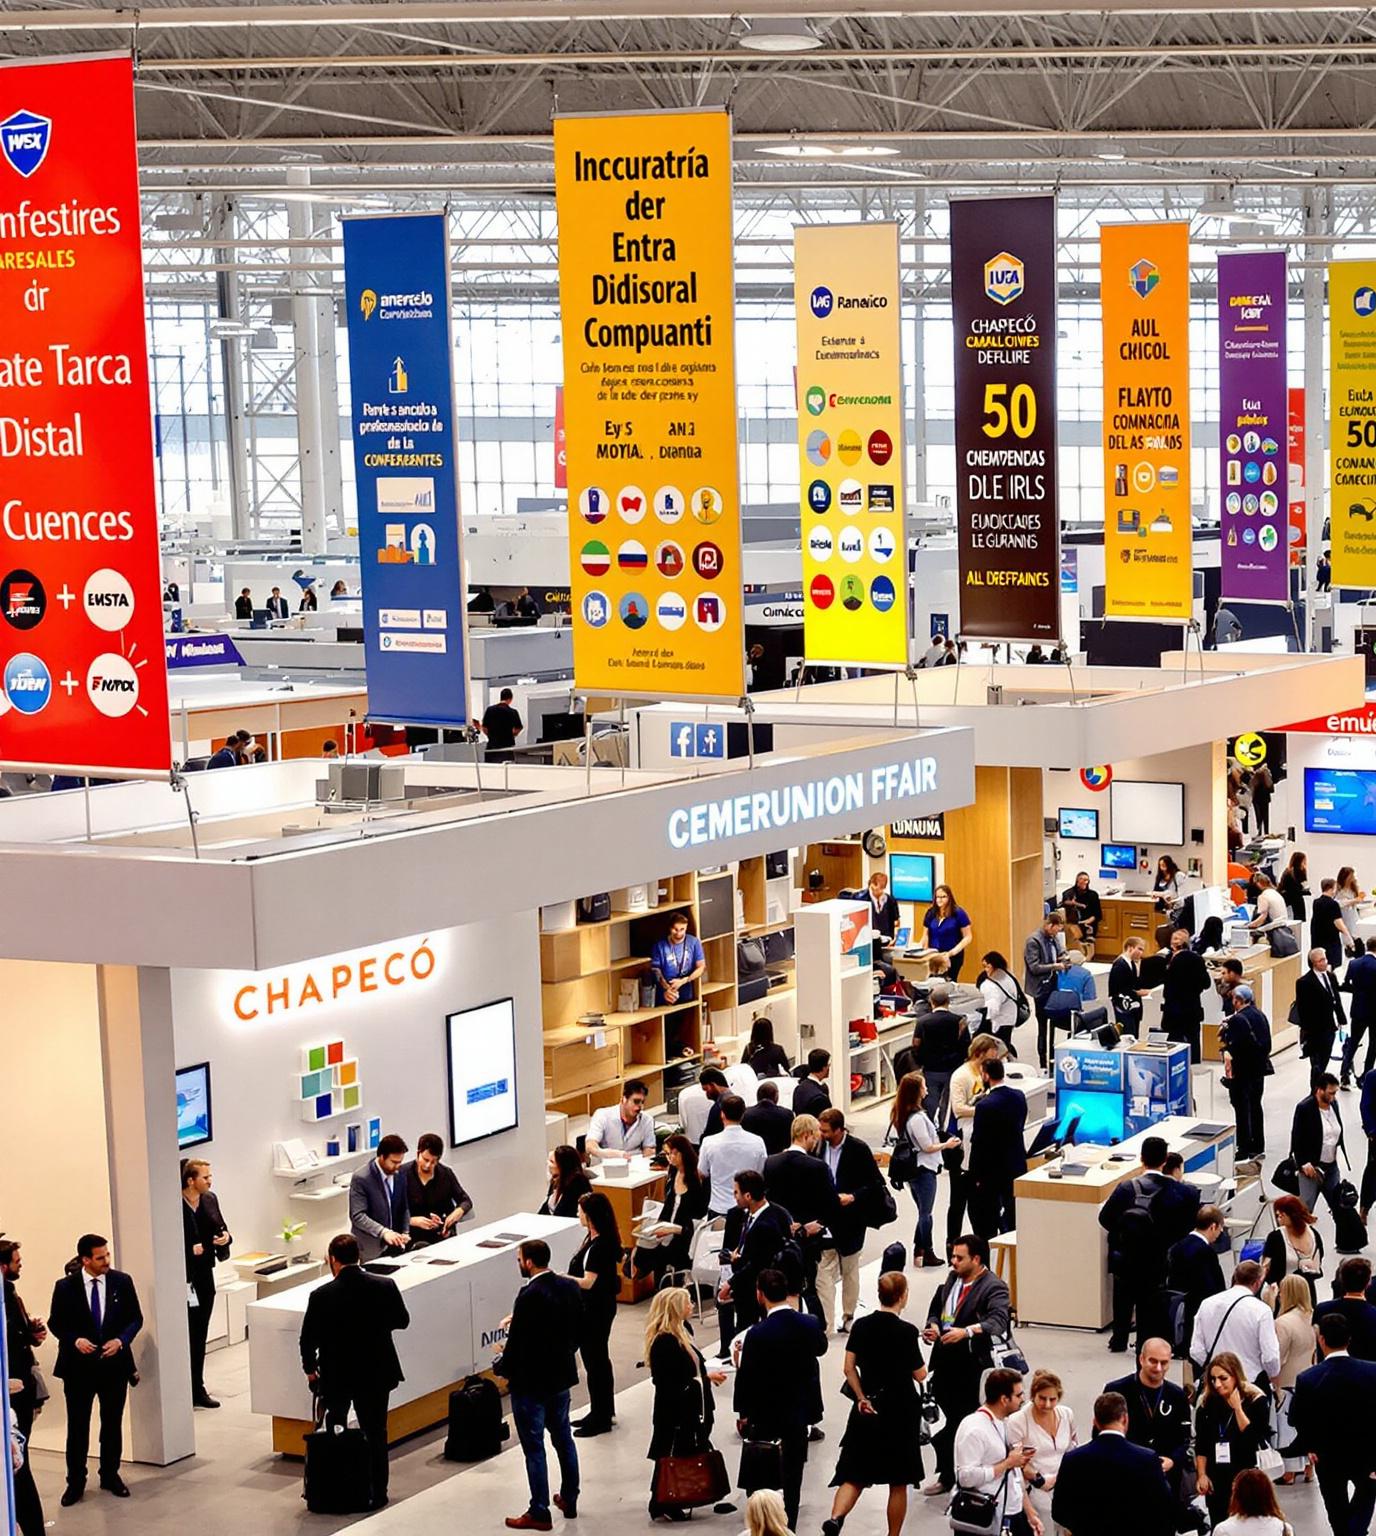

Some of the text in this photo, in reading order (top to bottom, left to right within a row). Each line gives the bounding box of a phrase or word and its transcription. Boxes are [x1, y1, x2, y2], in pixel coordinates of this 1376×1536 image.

[574, 147, 709, 182] Inccuratría
[625, 190, 665, 221] der
[612, 232, 676, 263] Entra
[592, 271, 698, 306] Didisoral
[584, 315, 712, 353] Compuanti
[1131, 318, 1160, 337] AUL
[49, 344, 132, 386] Tarca
[982, 383, 1037, 438] 50
[1119, 386, 1172, 408] FLAYTO
[0, 412, 84, 457] Distal
[968, 474, 1045, 500] DLE IRLS
[3, 500, 134, 541] Cuences
[668, 756, 938, 850] CEMERUNION FFAIR
[232, 936, 437, 1022] CHAPECÓ
